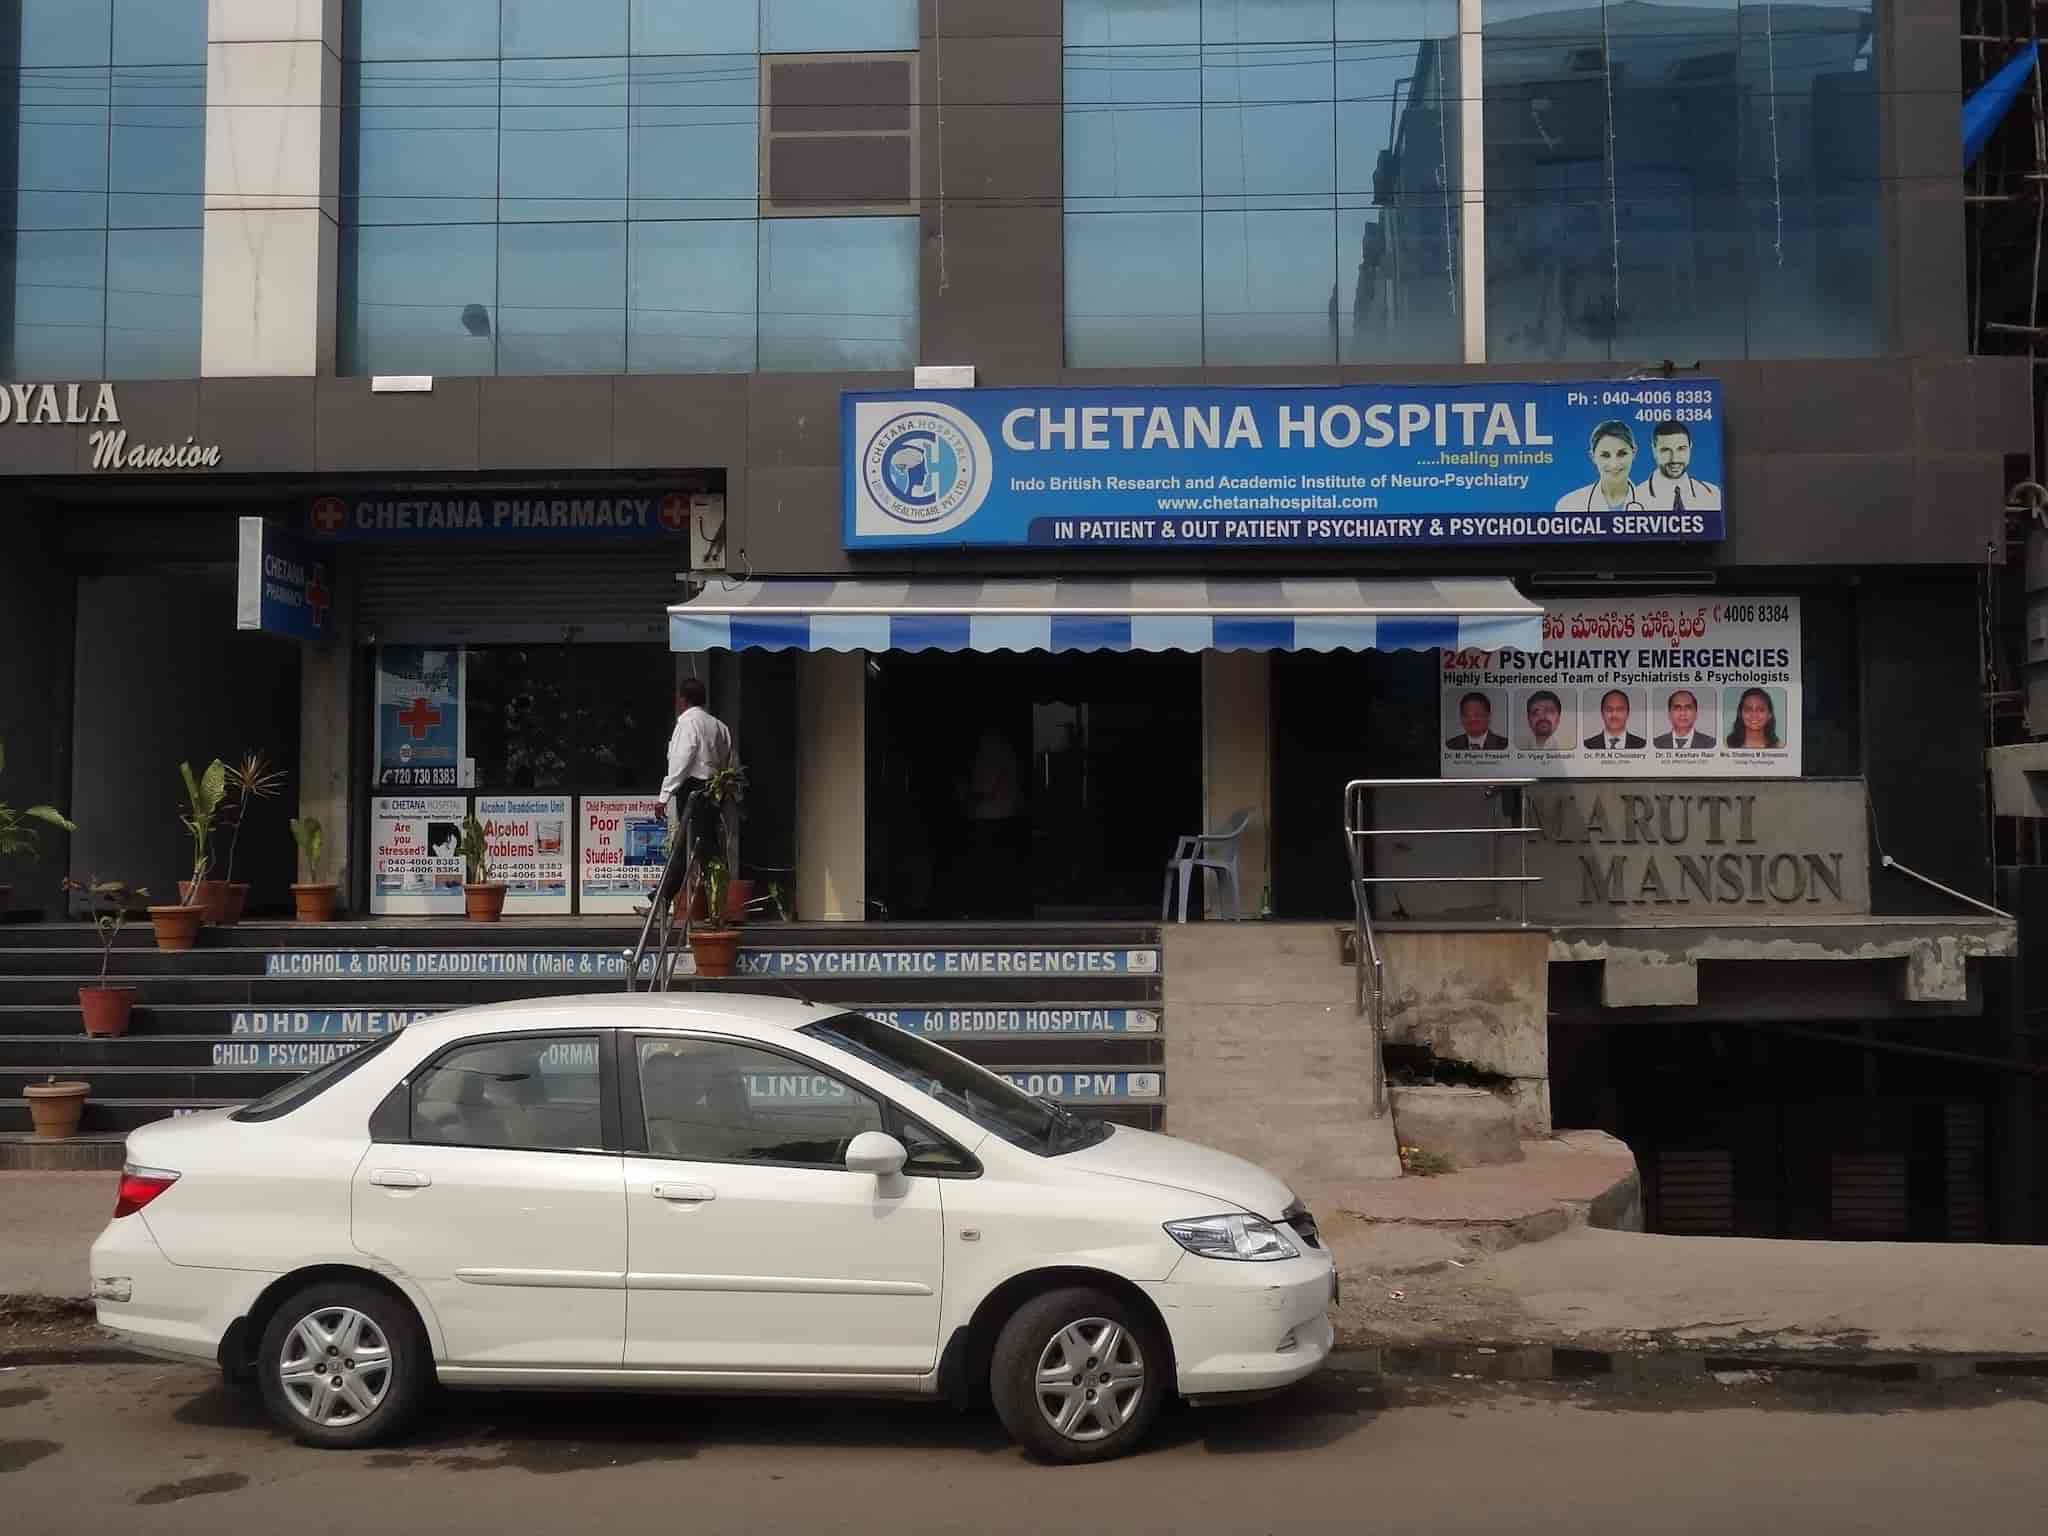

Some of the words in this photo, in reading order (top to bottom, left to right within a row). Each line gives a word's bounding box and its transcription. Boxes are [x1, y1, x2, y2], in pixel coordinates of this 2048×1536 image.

[1567, 392, 1588, 406] Ph
[1602, 391, 1671, 406] 040-4006
[1675, 390, 1713, 404] 8383
[1635, 408, 1672, 422] 4006
[1676, 408, 1713, 422] 8384
[1001, 405, 1263, 451] CHETANA
[1278, 402, 1554, 449] HOSPITAL
[89, 429, 221, 469] Mansion
[1503, 450, 1554, 465] minds
[1010, 477, 1046, 491] Indo
[1050, 476, 1101, 491] British
[1106, 476, 1180, 490] Research
[1185, 476, 1215, 489] and
[1220, 475, 1297, 490] Academic
[1301, 474, 1366, 488] Institute
[1370, 474, 1388, 488] of
[1391, 473, 1529, 490] Neuro-Psychiatry
[1157, 494, 1378, 512] www.chetanahospital.com
[355, 500, 483, 530] CHETANA
[492, 498, 650, 528] PHARMACY
[1055, 521, 1074, 539] IN
[1080, 520, 1156, 539] PATIENT
[1161, 520, 1176, 538] &
[1181, 520, 1219, 538] OUT
[1225, 519, 1300, 538] PATIENT
[1307, 518, 1424, 537] PSYCHIATRY
[1429, 518, 1444, 536] &
[1450, 517, 1607, 536] PSYCHOLOGICAL
[1612, 516, 1705, 535] SERVICES
[1723, 604, 1754, 623] 4006
[1759, 604, 1790, 622] 8384
[1443, 650, 1491, 670] 24x7
[1500, 650, 1629, 670] PSYCHIATRY
[1638, 649, 1790, 668] EMERGENCIES
[1443, 672, 1481, 686] Highly
[1484, 671, 1558, 686] Experienced
[1562, 671, 1594, 684] Team
[1597, 671, 1610, 684] of
[1613, 671, 1690, 686] Psychiatrists
[1694, 671, 1704, 682] &
[1707, 671, 1790, 686] Psychologists
[413, 768, 431, 785] 730
[394, 822, 411, 832] Are
[483, 818, 529, 837] Alcohol
[590, 815, 619, 831] Poor
[1526, 794, 1757, 845] MARUTI
[393, 836, 411, 846] you
[599, 833, 610, 845] in
[378, 846, 426, 856] Stressed?
[486, 841, 534, 857] roblems
[585, 847, 624, 865] Studies?
[1578, 852, 1844, 905] MANSION
[269, 954, 345, 974] ALCOHOL
[349, 954, 363, 973] &
[367, 953, 411, 973] DRUG
[416, 952, 528, 973] DEADDICTION
[532, 952, 574, 974] (Male
[579, 953, 593, 972] &
[597, 952, 657, 974] Feme)
[736, 953, 771, 974] 4x7
[780, 951, 937, 973] PSYCHIATRIC
[944, 950, 1117, 972] EMERGENCIES
[232, 1012, 310, 1034] ADHD
[923, 1011, 943, 1031] 60
[949, 1011, 1020, 1031] BEDDED
[1026, 1010, 1114, 1030] HOSPITAL
[212, 1044, 259, 1065] CHILD
[268, 1043, 360, 1065] PSYCHIAT
[744, 1074, 846, 1097] LINICS
[1074, 1074, 1116, 1096] PM
